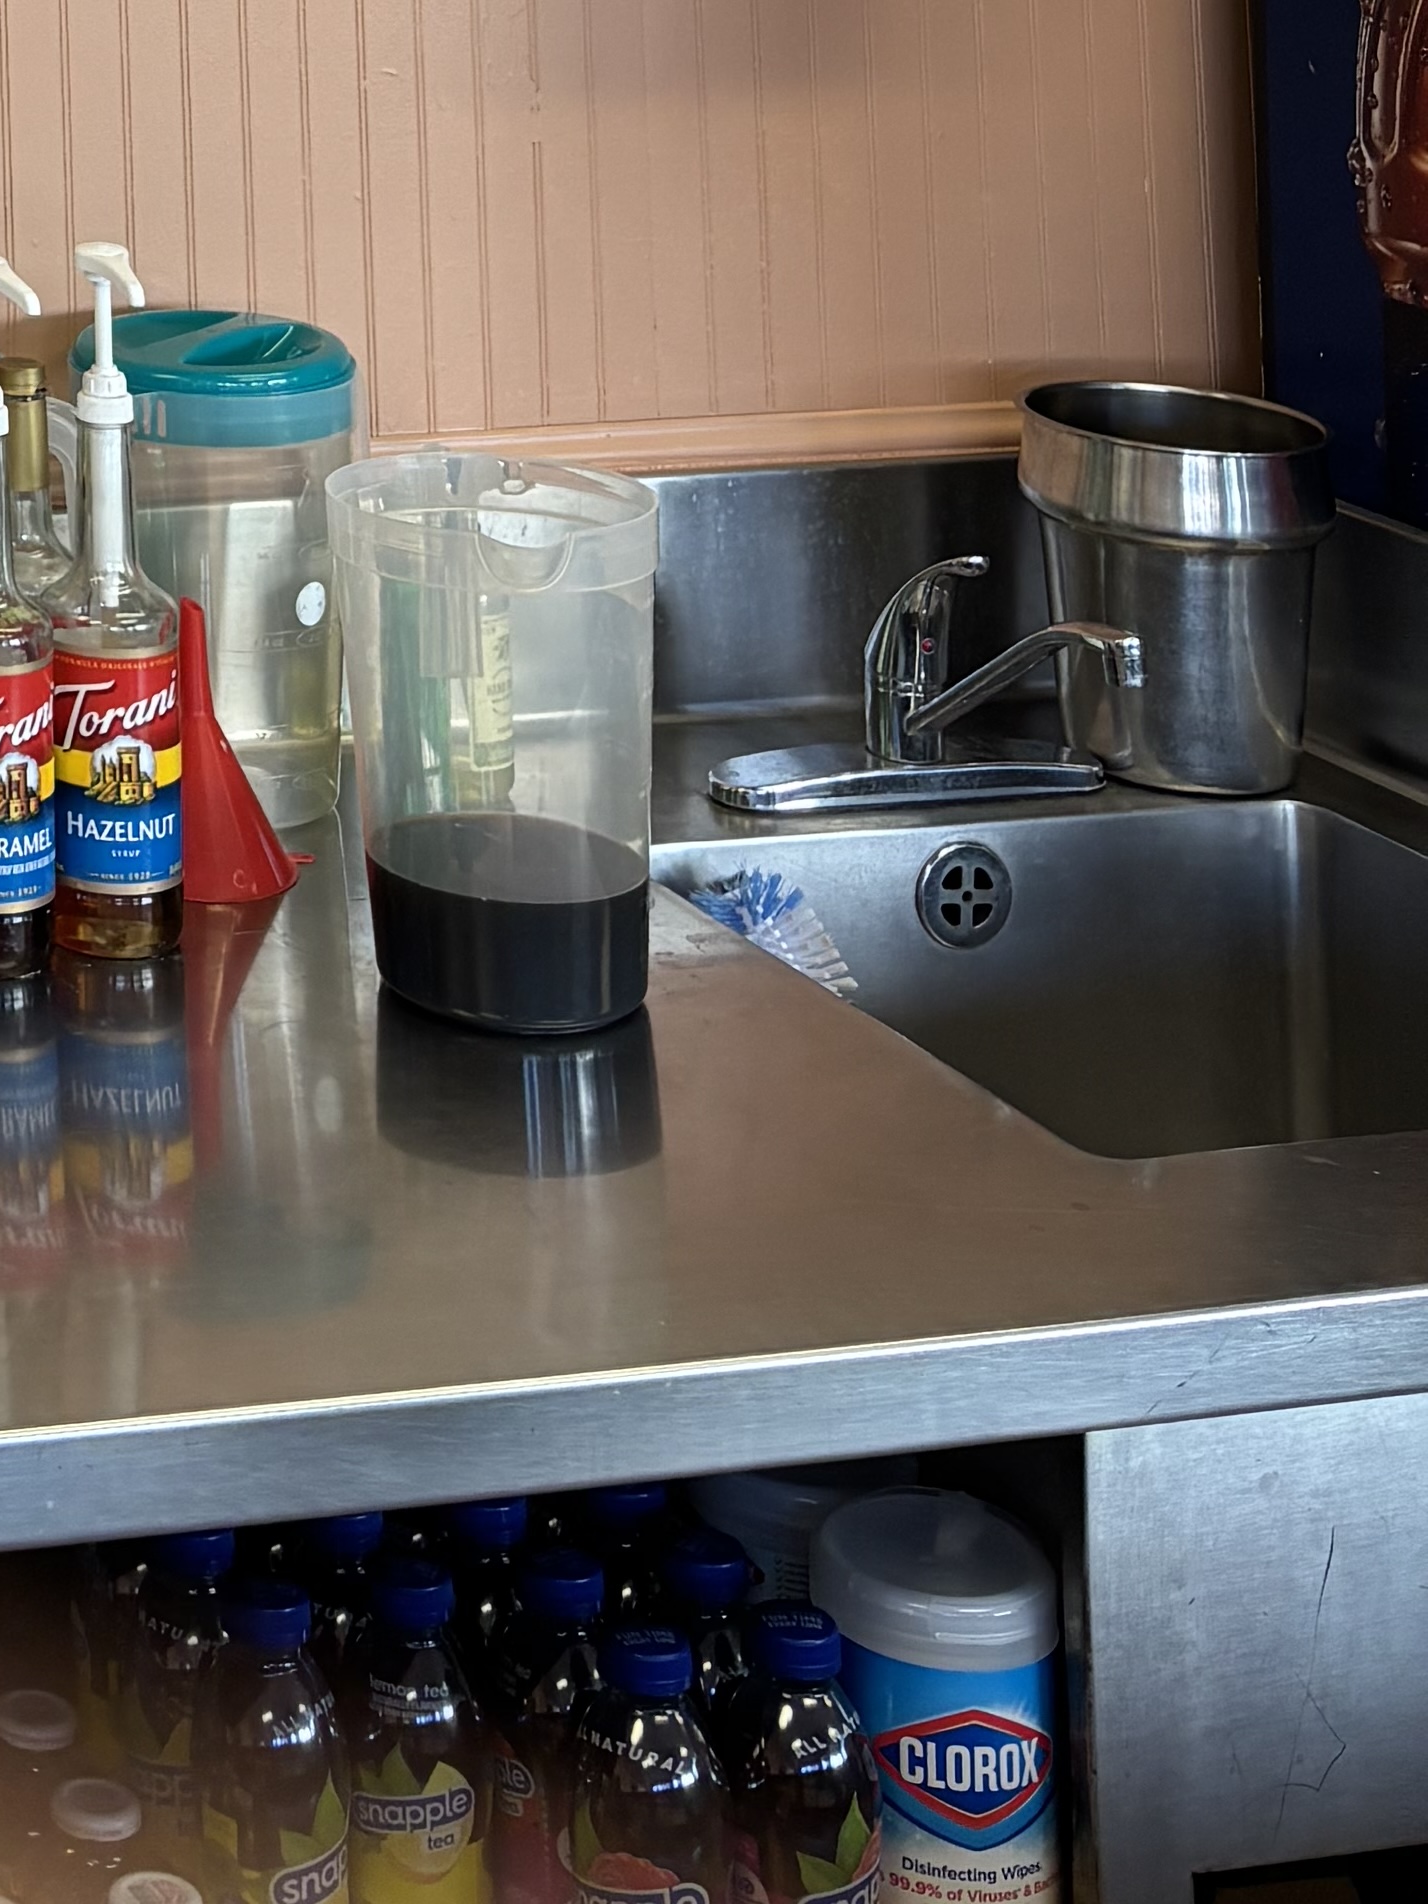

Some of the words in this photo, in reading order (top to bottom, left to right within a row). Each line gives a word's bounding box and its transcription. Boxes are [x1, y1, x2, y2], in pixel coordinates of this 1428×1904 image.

[53, 669, 177, 751] Torani
[67, 810, 176, 842] HAZELNUT
[111, 849, 141, 857] SYRUP
[899, 1736, 1039, 1792] CLOROX
[356, 1788, 469, 1833] snapple
[427, 1831, 456, 1851] tea
[902, 1856, 997, 1884] Disinfecting
[1002, 1861, 1041, 1881] Wipes
